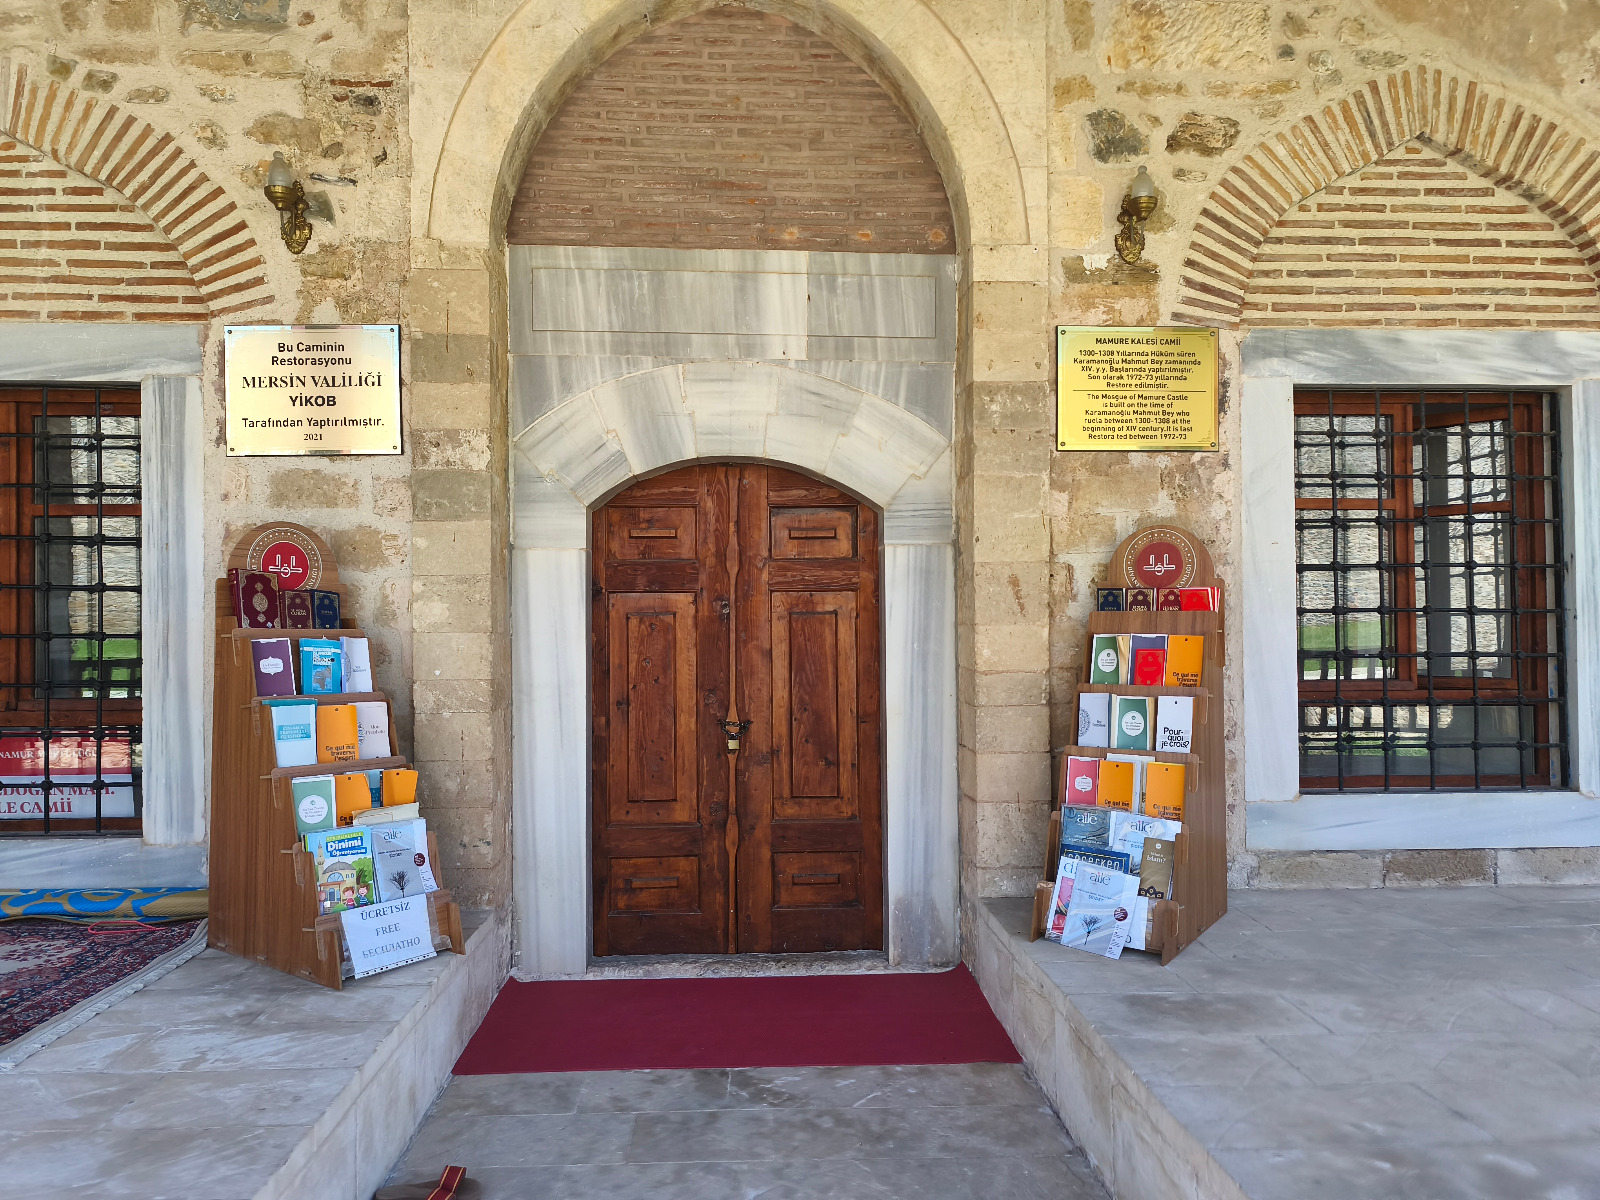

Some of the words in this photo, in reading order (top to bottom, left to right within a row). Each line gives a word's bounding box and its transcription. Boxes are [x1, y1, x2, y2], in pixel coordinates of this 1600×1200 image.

[278, 342, 293, 352] Bu
[296, 342, 345, 352] Caminin
[1131, 337, 1158, 345] KALESİ
[1160, 337, 1181, 346] CAMİİ
[271, 356, 352, 367] Restorasyonu
[1151, 358, 1163, 366] Bey
[242, 373, 306, 388] MERSİN
[310, 372, 382, 388] VALİLİĞİ
[289, 393, 337, 407] YİKOB
[242, 417, 303, 428] Tarafından
[306, 417, 385, 429] Yaptırılmıştır.
[1164, 727, 1184, 735] Pour-
[1161, 741, 1168, 749] je
[0, 781, 64, 795] DOĞN
[1077, 812, 1097, 824] aile
[1130, 820, 1152, 833] aile
[383, 829, 402, 840] aile
[327, 837, 361, 851] Dinimi
[1090, 872, 1110, 885] aile
[360, 901, 410, 920] ÜCRETSİZ
[376, 923, 400, 936] FREE
